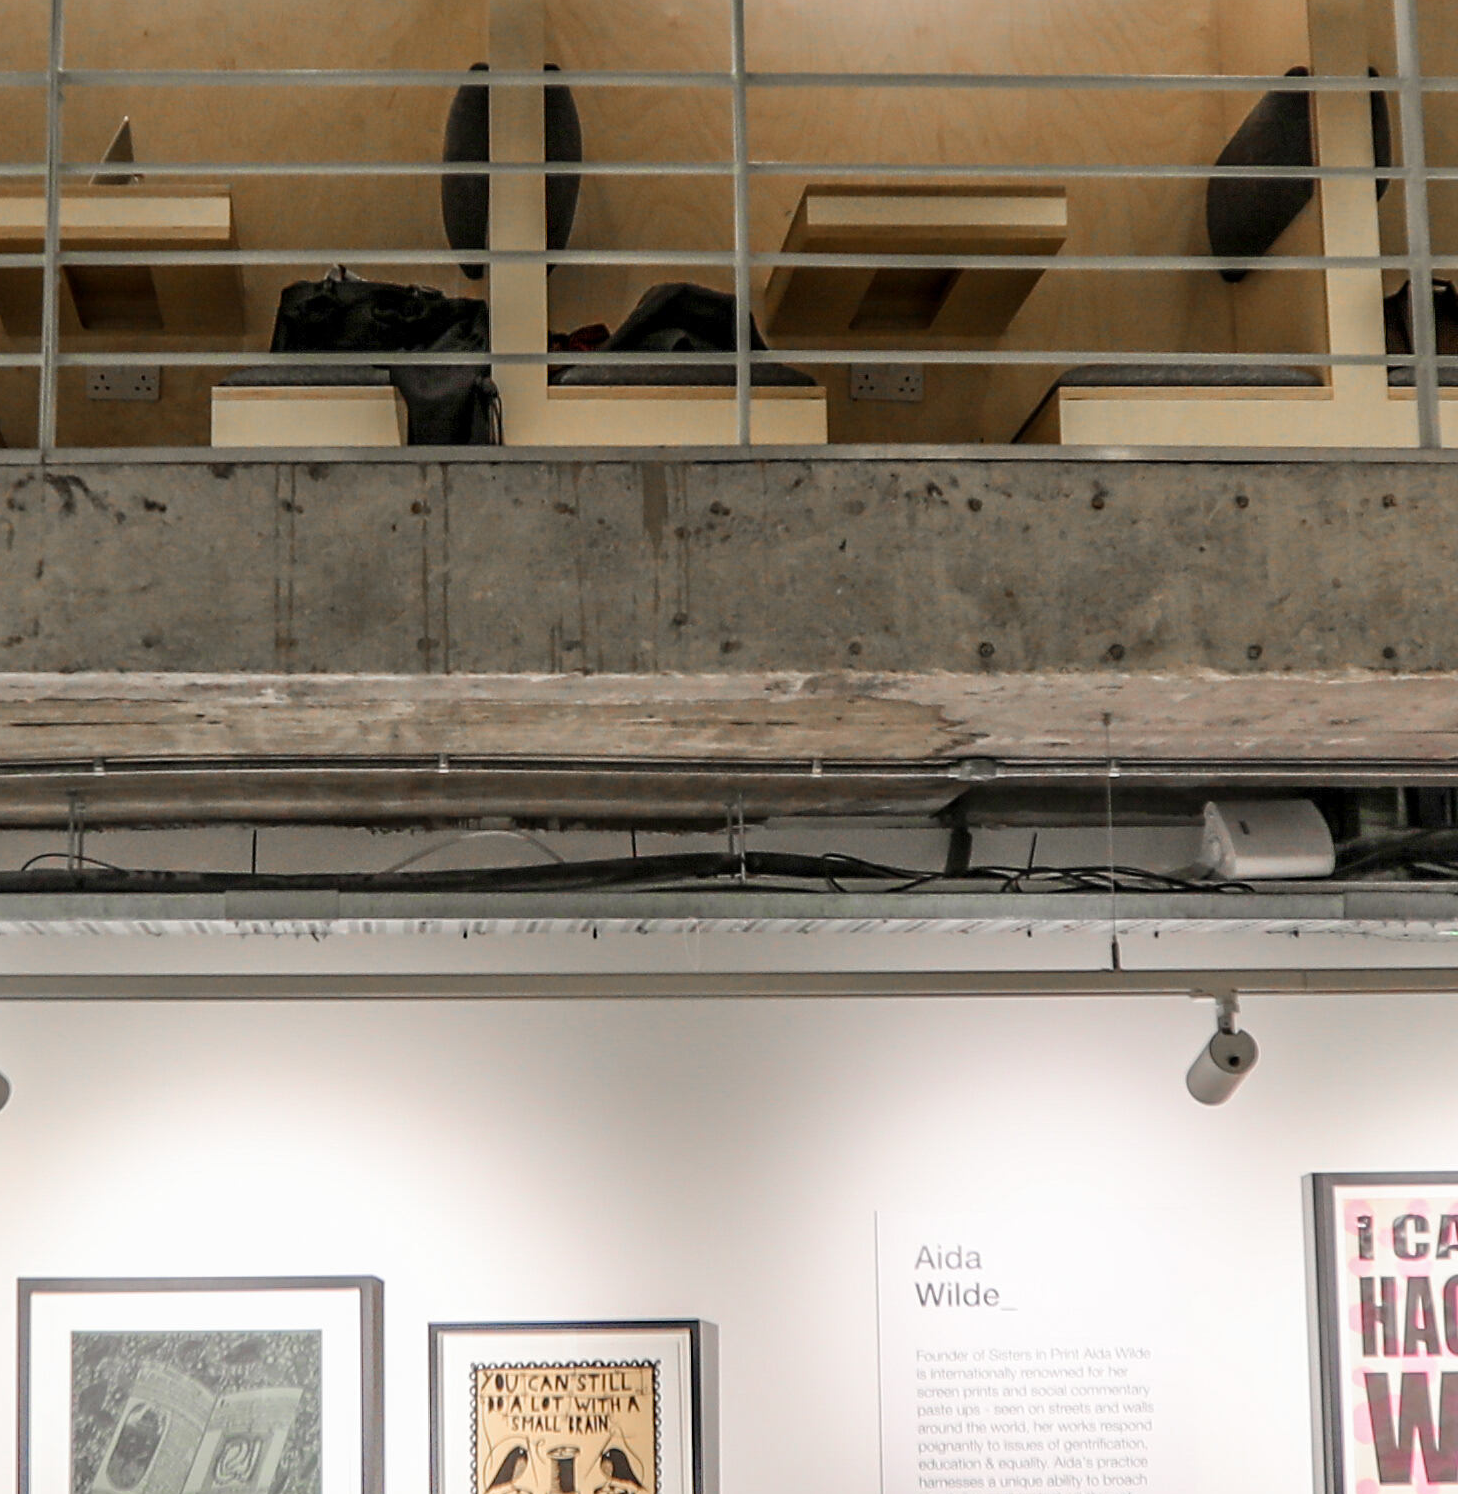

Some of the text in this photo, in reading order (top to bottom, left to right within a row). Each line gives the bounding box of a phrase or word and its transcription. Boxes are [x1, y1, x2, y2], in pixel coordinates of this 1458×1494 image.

[914, 1244, 983, 1270] Aida
[915, 1347, 1152, 1362] Founder of Sisters in Print Aida Wilde
[482, 1371, 632, 1394] YOU CAN STILL
[488, 1396, 640, 1413] DO A LOT WITH A
[512, 1415, 609, 1434] SMALL BRAIN
[917, 1421, 963, 1434] around
[965, 1421, 987, 1434] the
[1033, 1420, 1054, 1433] her
[1057, 1420, 1097, 1432] works
[1099, 1419, 1152, 1434] respond
[918, 1457, 982, 1471] education
[984, 1457, 994, 1470] &
[1053, 1456, 1094, 1469] Aida's
[1096, 1455, 1149, 1471] practice
